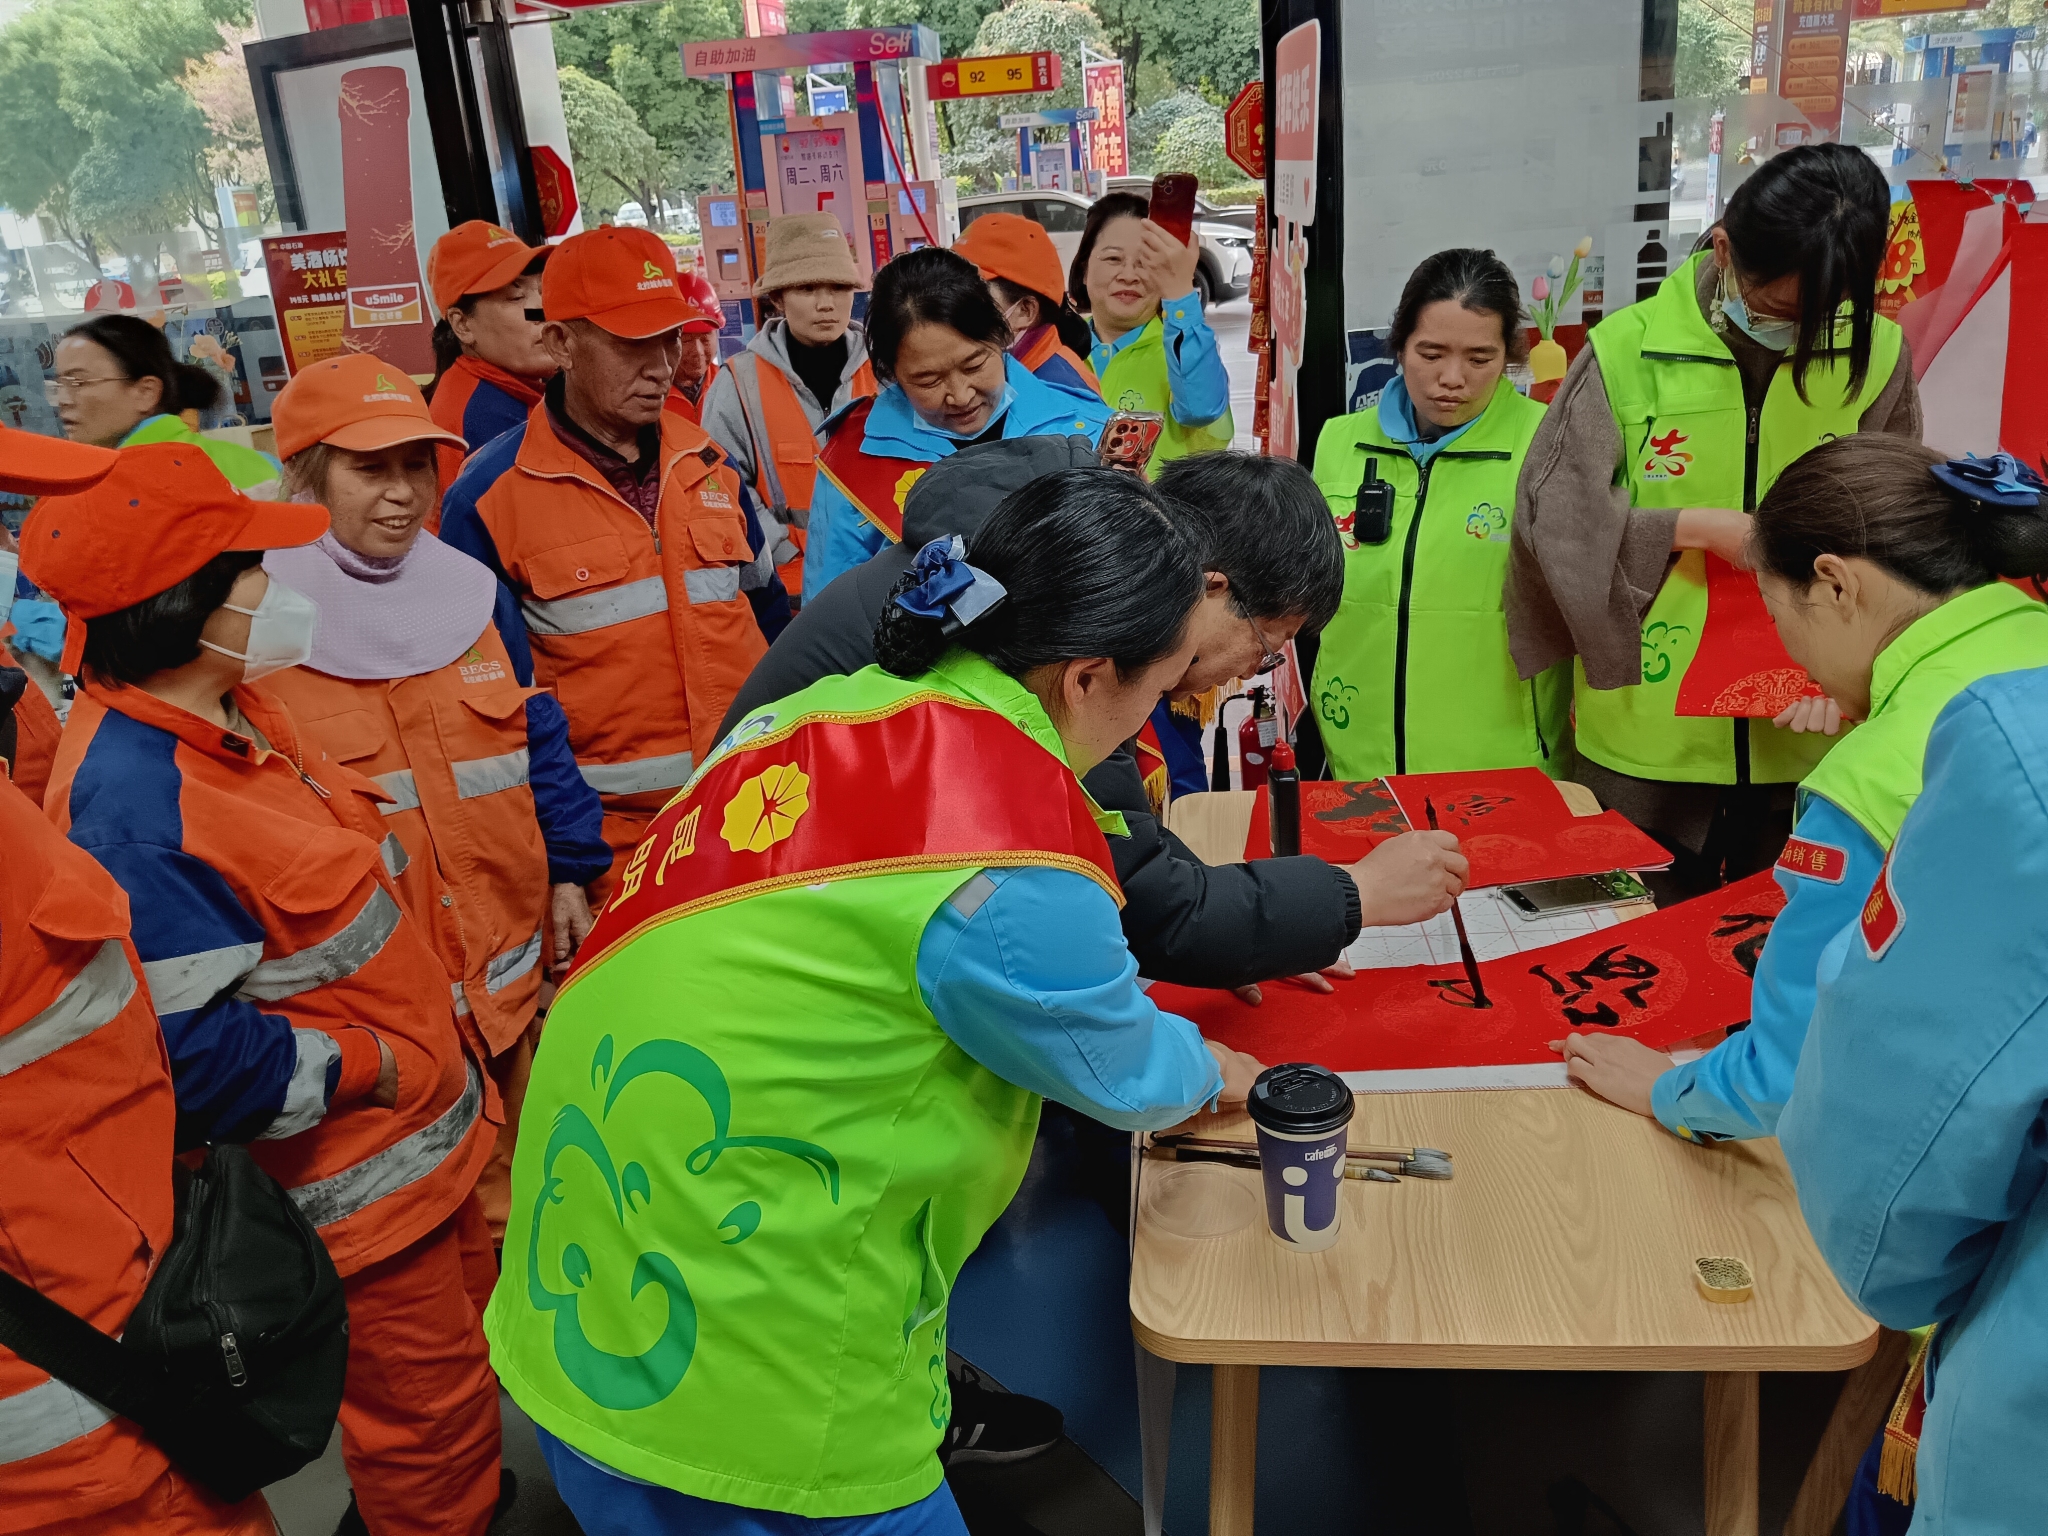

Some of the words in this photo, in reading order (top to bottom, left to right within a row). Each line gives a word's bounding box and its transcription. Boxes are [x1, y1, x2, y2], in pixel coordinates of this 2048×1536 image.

[1798, 14, 1834, 28] 充值赢大奖
[869, 31, 912, 55] Self
[695, 47, 756, 67] 自助加油
[969, 71, 986, 83] 92
[1006, 68, 1023, 80] 95
[1093, 86, 1120, 130] 免费
[1092, 132, 1122, 173] 洗车
[786, 164, 844, 186] 周二、周六
[874, 217, 885, 227] 19
[756, 226, 765, 234] 20
[302, 269, 347, 289] 大礼包
[365, 292, 404, 305] uSmile
[700, 491, 729, 502] BECS
[458, 660, 501, 676] BECS
[1305, 1149, 1323, 1162] cafe
